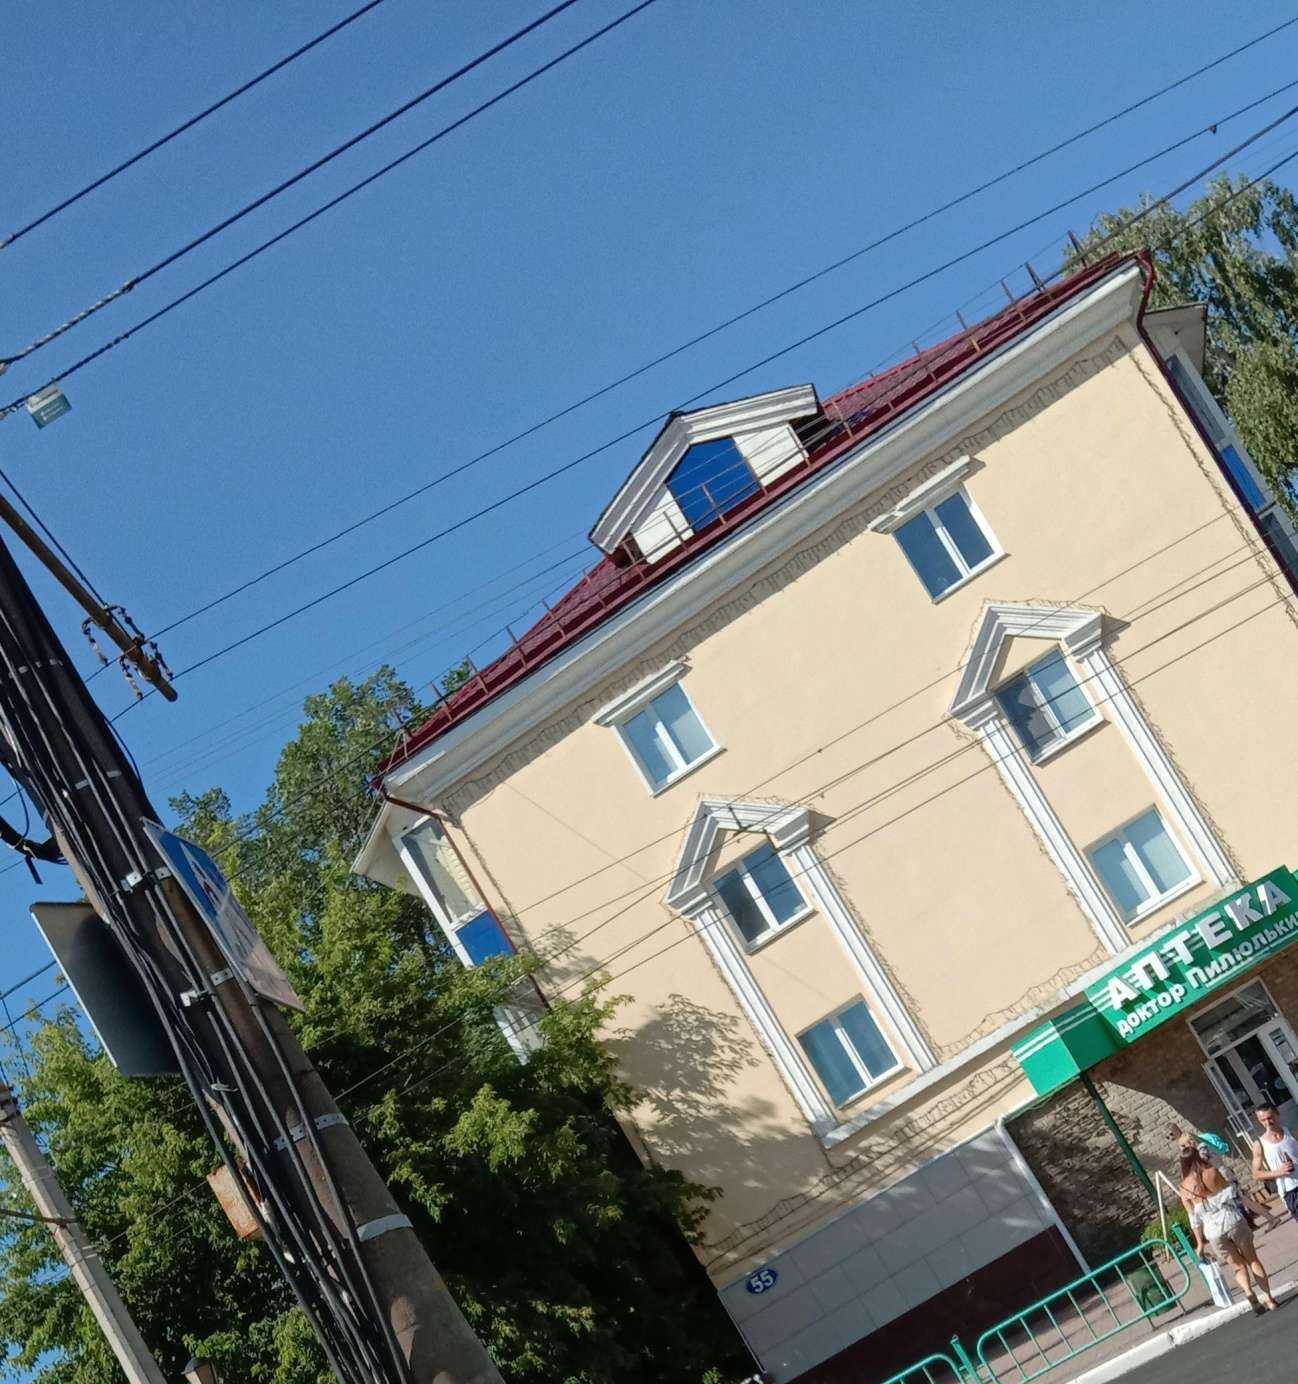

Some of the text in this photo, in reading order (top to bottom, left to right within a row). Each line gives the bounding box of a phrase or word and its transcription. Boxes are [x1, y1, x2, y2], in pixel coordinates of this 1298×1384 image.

[1108, 880, 1292, 1010] АПТЕКА
[1186, 911, 1298, 989] Пилюльки
[751, 1270, 774, 1293] 55
